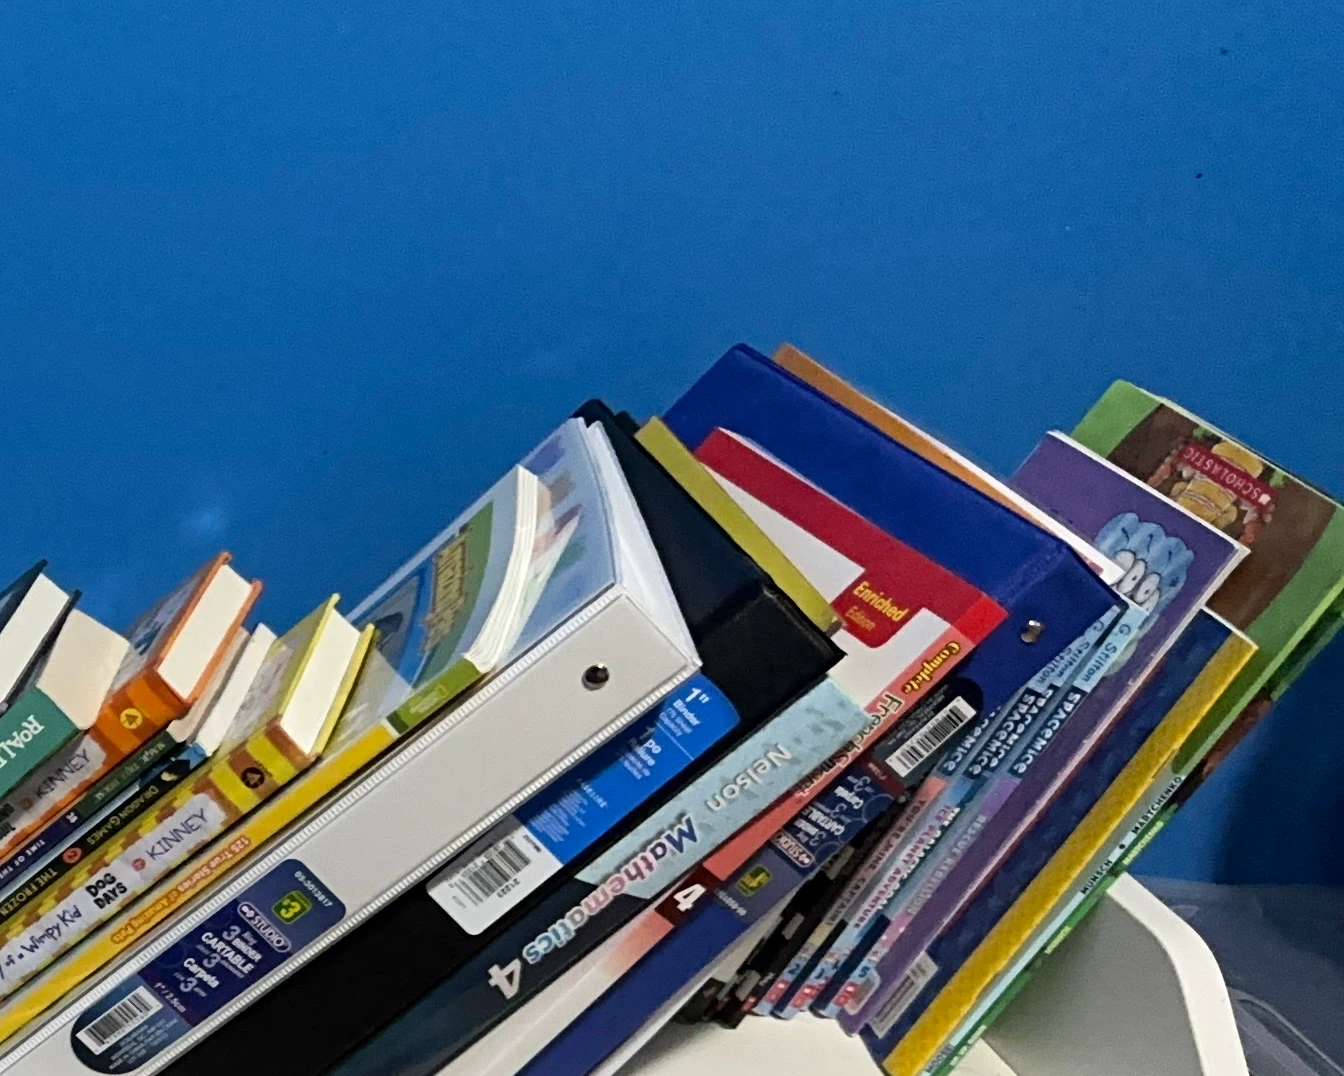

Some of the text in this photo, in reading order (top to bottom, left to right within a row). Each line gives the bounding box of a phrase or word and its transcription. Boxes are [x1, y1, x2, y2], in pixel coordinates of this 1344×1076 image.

[1182, 445, 1262, 501] SCHOLASTIC
[851, 577, 910, 624] Enriched
[899, 640, 963, 697] Complete
[1080, 641, 1118, 683] Stilton
[672, 697, 700, 729] Binder
[682, 684, 709, 711] 1"
[657, 710, 682, 739] Capacity
[642, 737, 662, 757] po
[30, 748, 93, 802] KINNEY
[704, 742, 791, 813] Nelson
[852, 772, 871, 794] 3
[83, 783, 160, 846] DRAGON GAMES
[26, 838, 46, 856] TIME
[143, 806, 211, 862] KINNEY
[1079, 774, 1183, 895] MUNSCH MARTCHENKO
[14, 851, 29, 866] OF
[33, 865, 58, 887] THE
[85, 870, 117, 898] DOG
[93, 880, 129, 911] DAYS
[108, 834, 250, 945] 125 True Stories Amazing Pets
[520, 812, 699, 967] Mathematics
[669, 875, 707, 915] 4
[852, 866, 903, 930] ADVENTURE
[2, 954, 17, 969] of
[21, 919, 65, 958] Wimpy
[57, 902, 83, 928] Kid
[220, 922, 242, 943] 3
[231, 936, 262, 962] BINDER
[250, 914, 285, 948] STUDIO
[200, 930, 254, 974] CARTABLE
[201, 950, 222, 970] 3
[177, 974, 198, 994] 3
[182, 956, 220, 989] Carpeta
[487, 961, 522, 1000] 4
